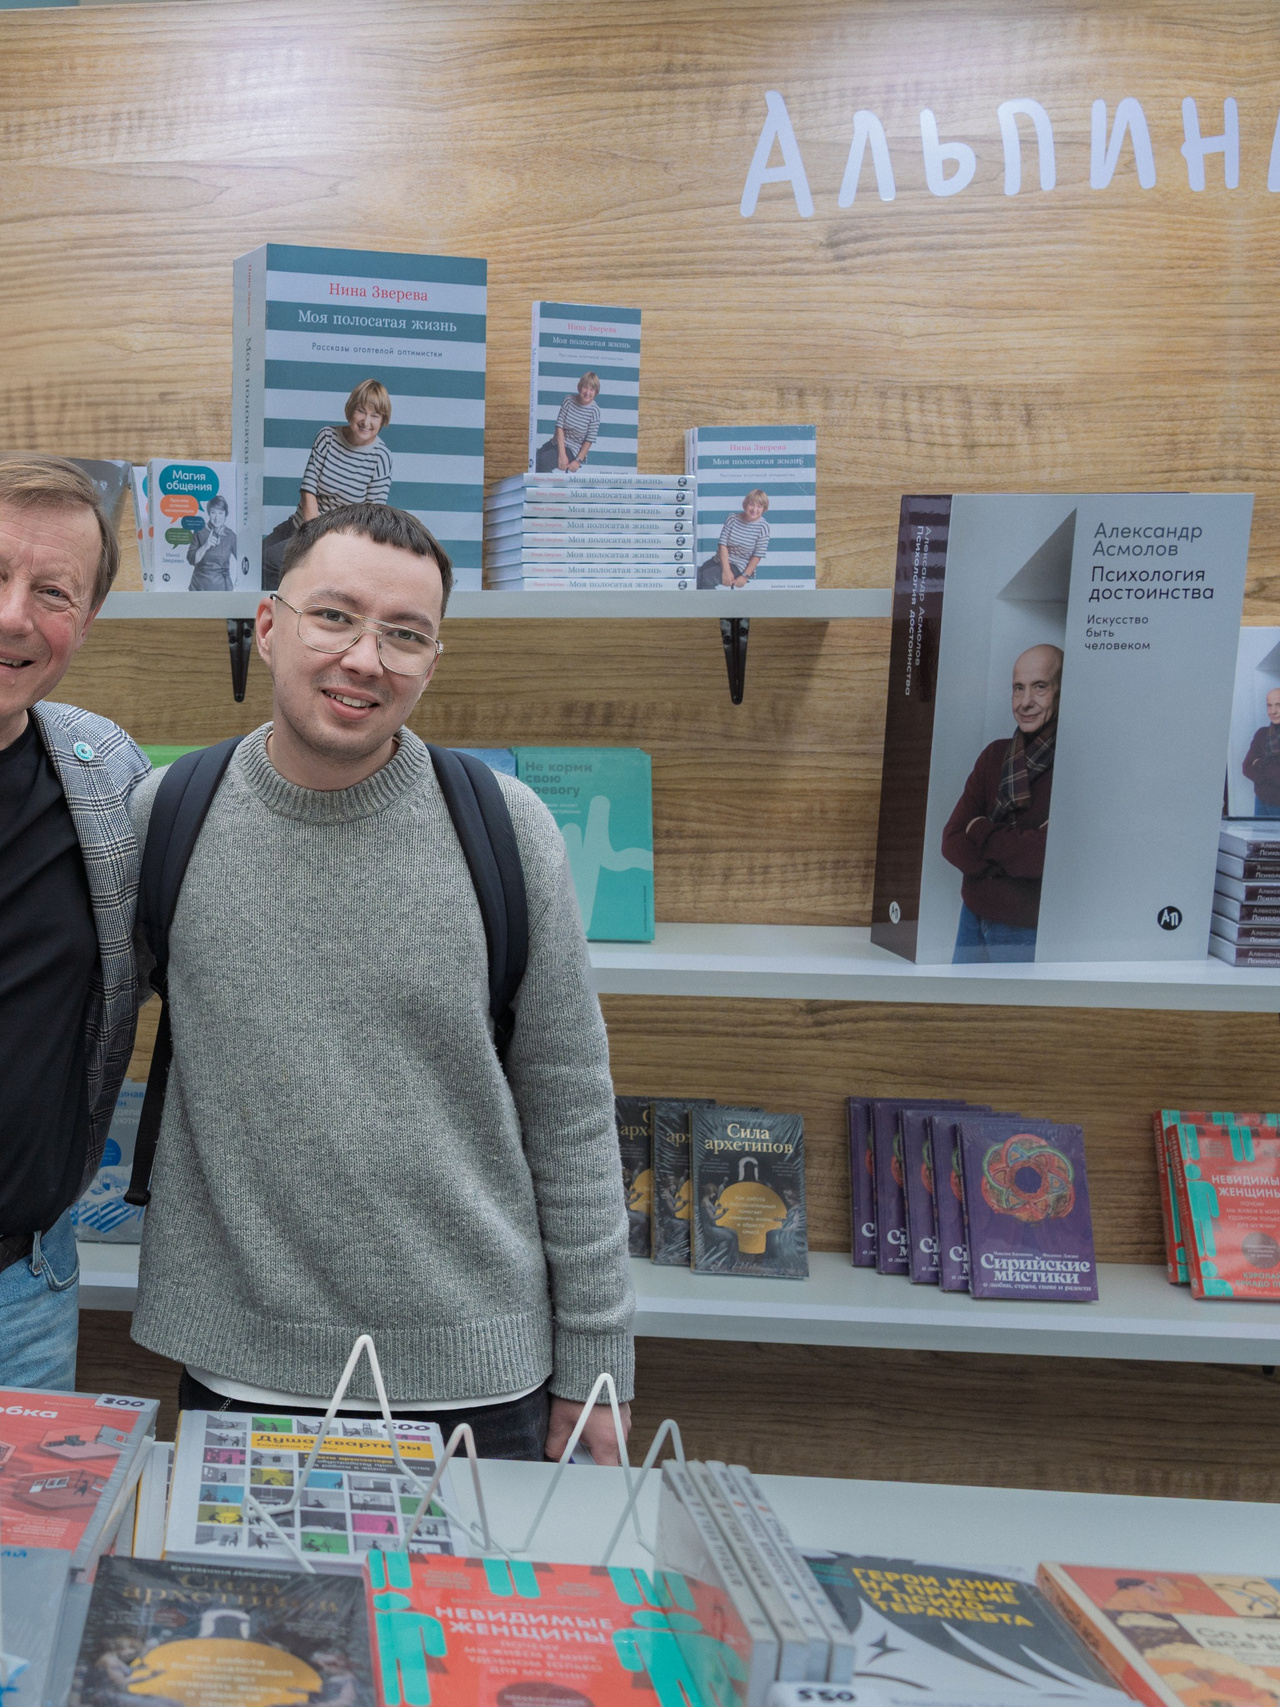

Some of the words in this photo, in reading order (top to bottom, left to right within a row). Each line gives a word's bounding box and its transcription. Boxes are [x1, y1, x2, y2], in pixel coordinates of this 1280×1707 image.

[329, 283, 367, 298] Нина
[372, 286, 428, 303] Зверева
[298, 310, 328, 325] Моя
[333, 316, 407, 329] полосатая
[412, 319, 457, 333] жизнь
[312, 342, 350, 352] Рассказы
[353, 345, 394, 355] оголтелой
[397, 349, 443, 358] оптимистки
[570, 339, 606, 347] полосатая
[608, 341, 631, 349] жизнь
[712, 457, 729, 465] Моя
[732, 458, 774, 466] полосатая
[172, 469, 206, 481] Магия
[569, 476, 587, 484] Моя
[589, 477, 633, 485] полосатая
[166, 482, 212, 492] общения
[1094, 522, 1203, 543] Александр
[1092, 540, 1178, 556] Асмолов
[911, 525, 924, 605] Психология
[919, 526, 932, 602] Александр
[1091, 566, 1205, 582] Психология
[1089, 587, 1214, 602] достоинства
[1087, 614, 1149, 627] Искусство
[915, 606, 925, 666] Асмолов
[1086, 627, 1115, 638] быть
[905, 609, 915, 696] достоинства
[1084, 642, 1150, 650] человеком
[525, 761, 543, 772] Не
[548, 763, 593, 775] корми
[525, 774, 561, 783] свою
[531, 786, 580, 798] ревогу
[726, 1123, 770, 1140] Сила
[704, 1139, 794, 1154] архетипов
[1211, 1174, 1280, 1186] НЕВИДИМЫ
[980, 1253, 1091, 1275] Сирийские
[993, 1270, 1080, 1284] мистики
[257, 1435, 315, 1446] Душа
[852, 1568, 940, 1587] ГЕРОИ
[946, 1577, 1018, 1593] КНИГ
[859, 1579, 899, 1593] НА
[903, 1583, 1020, 1605] ПРИЕМЕ
[891, 1592, 995, 1611] ПСИХО-
[435, 1606, 614, 1631] НЕВИДИМЫЕ
[873, 1600, 1035, 1627] ТЕРАПЕВТА
[449, 1621, 607, 1644] ЖЕНЩИНЫ
